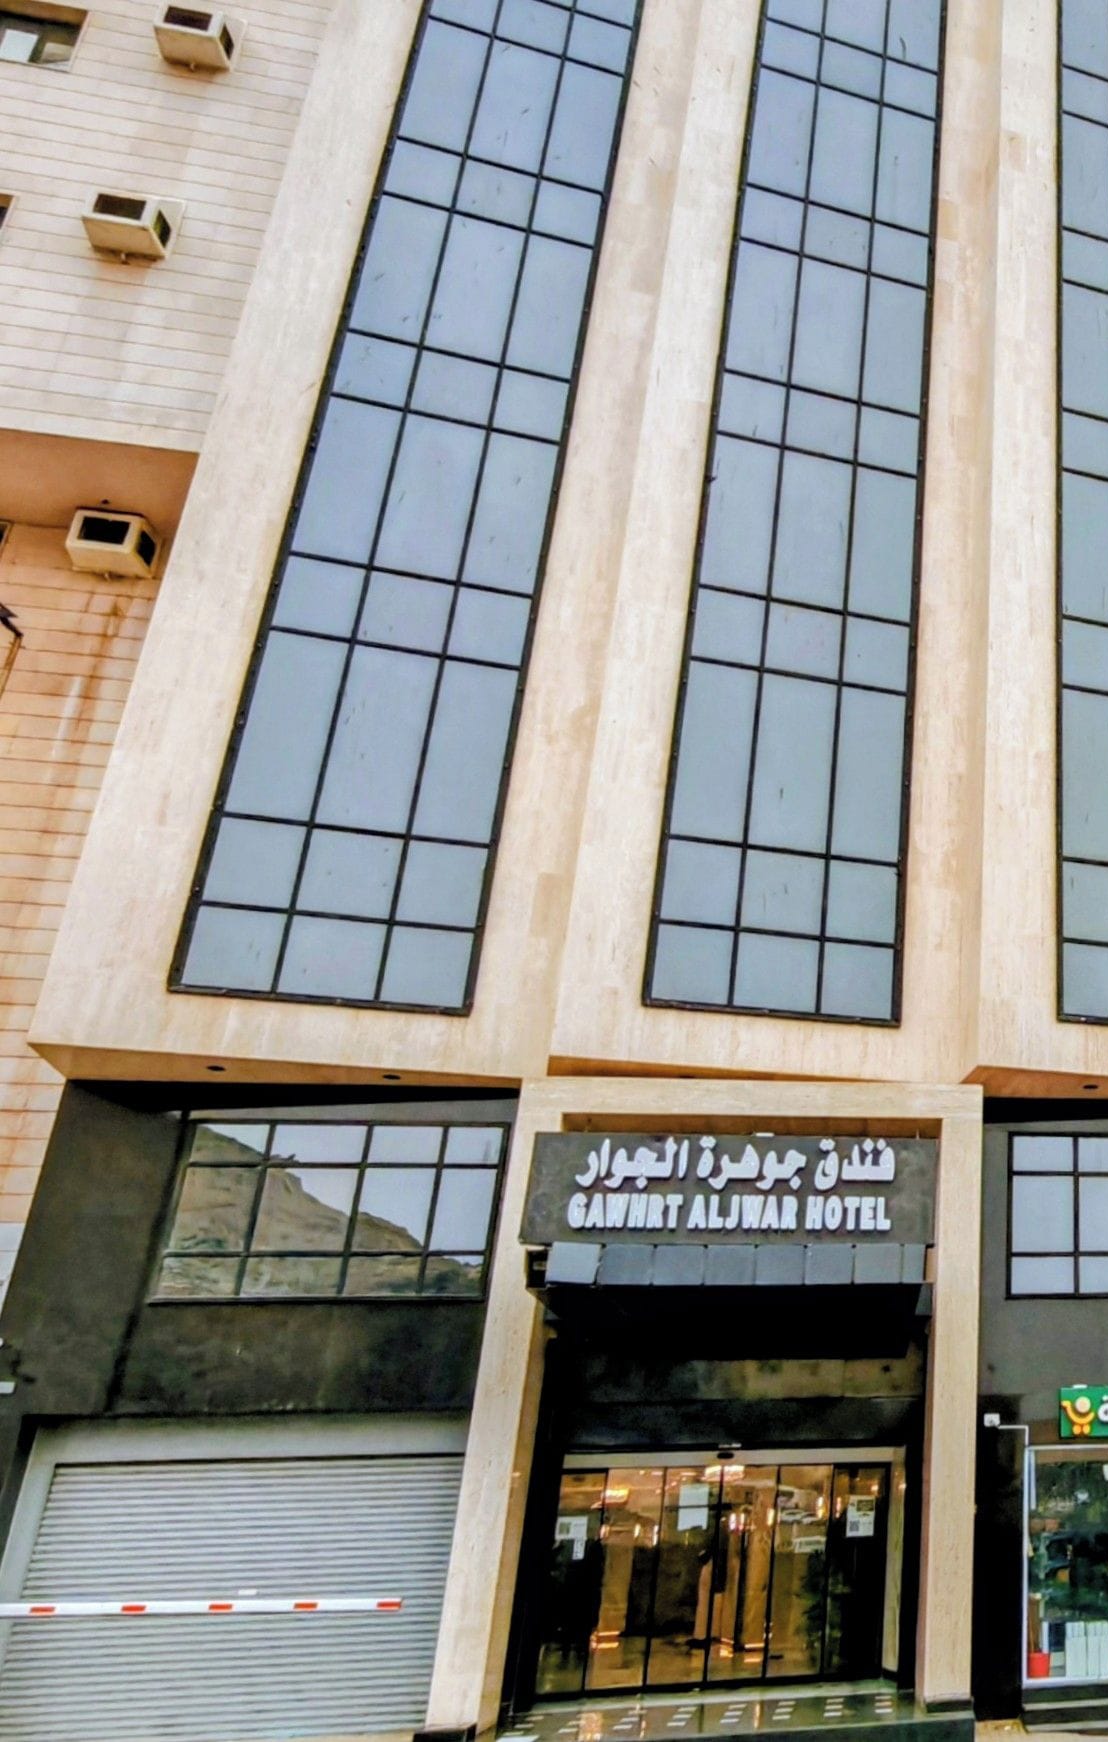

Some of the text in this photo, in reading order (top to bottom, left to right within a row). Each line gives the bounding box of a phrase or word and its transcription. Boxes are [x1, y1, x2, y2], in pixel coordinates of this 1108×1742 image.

[575, 1135, 896, 1191] فندق جوهرة الجوار
[567, 1192, 892, 1231] GAWHRT ALJWAR HOTEL
